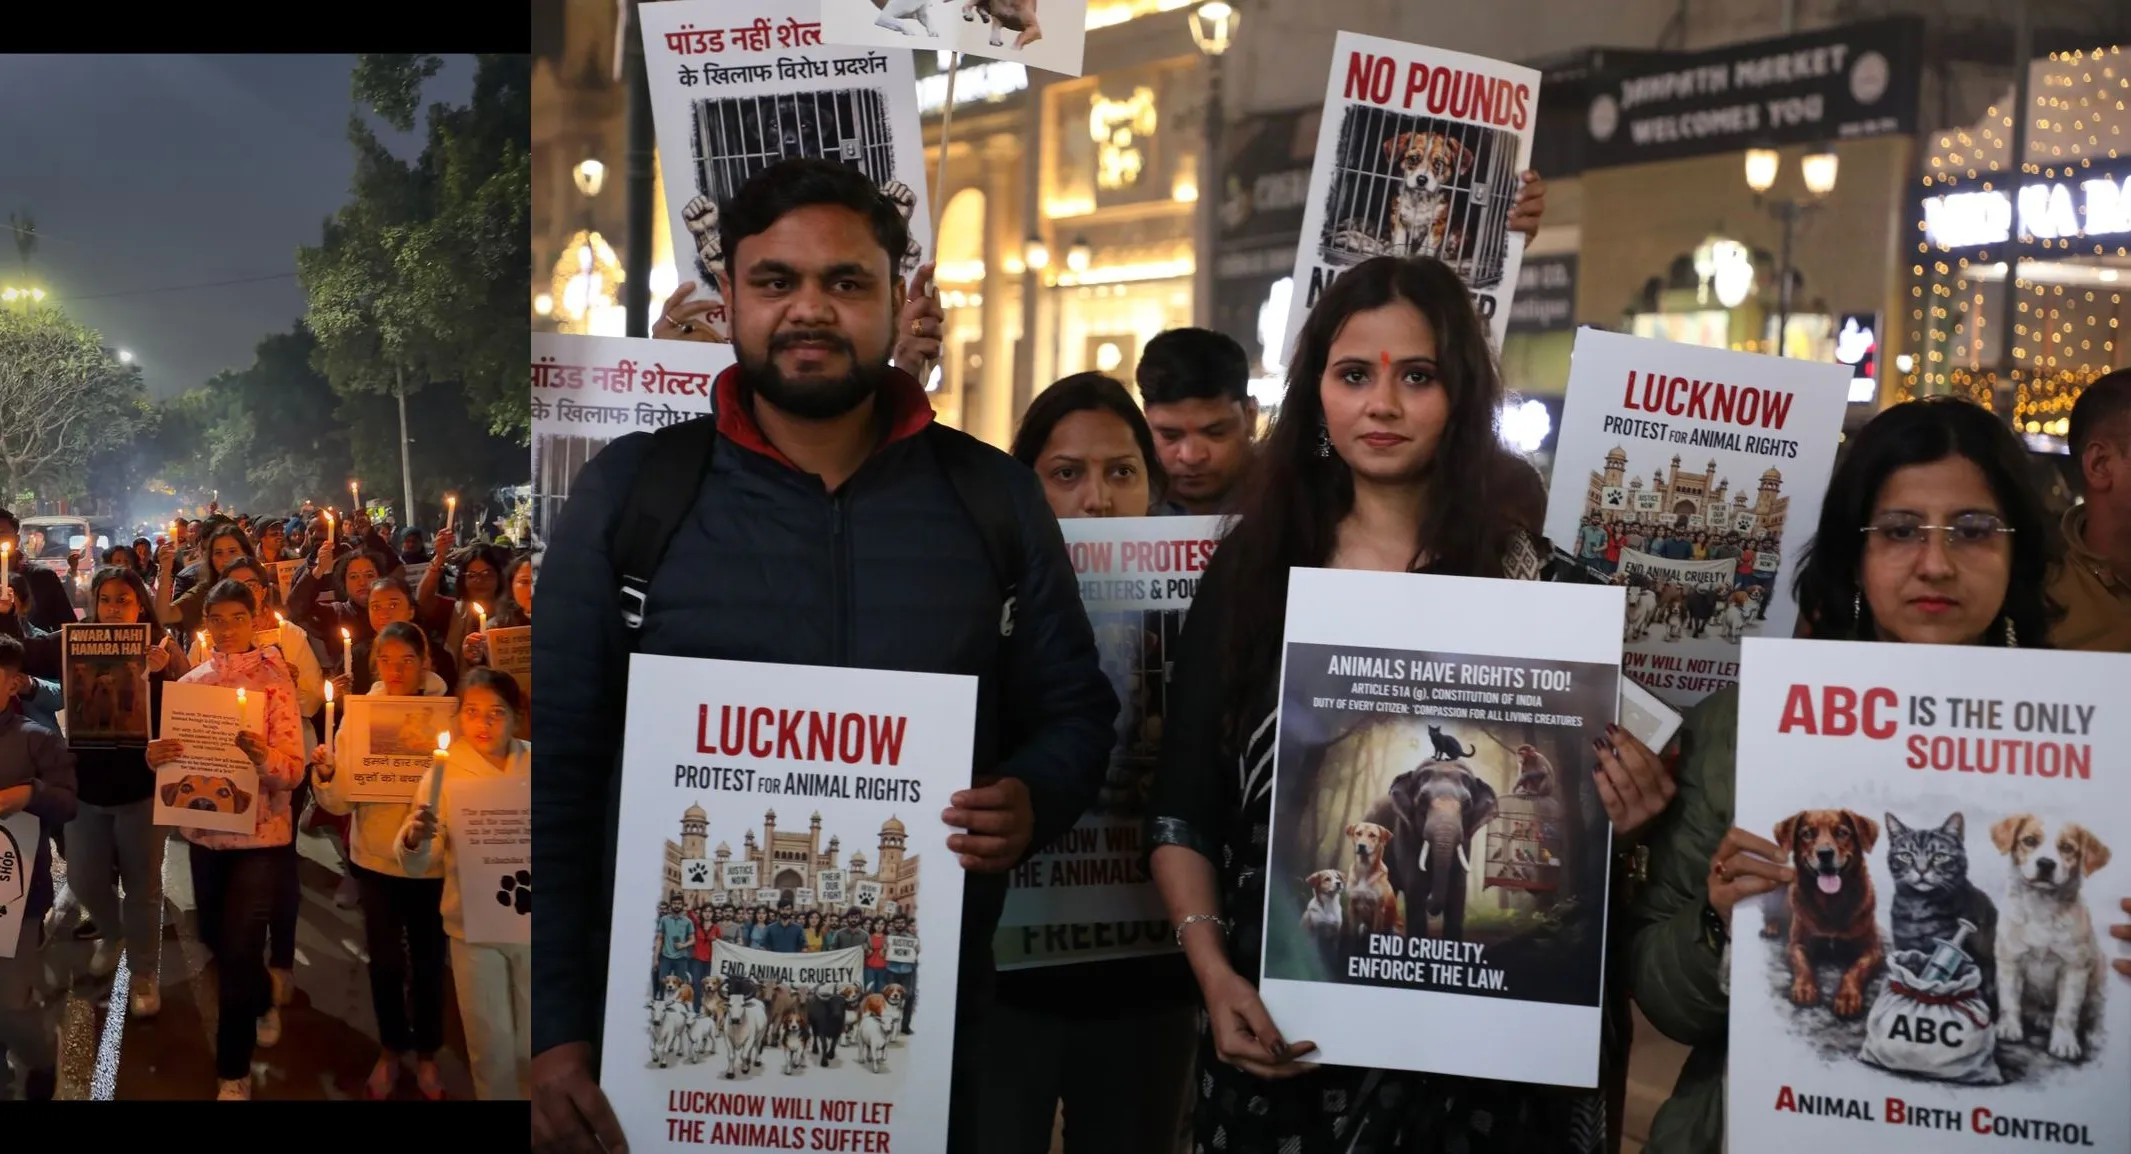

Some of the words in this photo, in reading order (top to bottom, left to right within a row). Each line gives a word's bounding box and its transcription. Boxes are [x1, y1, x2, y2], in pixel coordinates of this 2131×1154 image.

[730, 17, 772, 52] नहीं
[678, 64, 698, 87] के
[703, 62, 772, 86] खिलाफ
[776, 56, 828, 81] विरोध
[1733, 43, 1849, 87] MARKET
[1343, 51, 1396, 105] NO
[1403, 61, 1530, 131] POUNDS
[1630, 103, 1761, 145] WELCOMES
[1766, 93, 1824, 128] YOU
[592, 359, 638, 393] नहीं
[641, 362, 711, 397] शेल्टर
[556, 398, 630, 425] खिलाफ
[1623, 370, 1794, 430] LUCKNOW
[1603, 415, 1669, 441] PROTEST
[1669, 429, 1688, 445] FOR
[1689, 428, 1743, 452] ANIMAL
[1745, 435, 1798, 459] RIGHTS
[1079, 579, 1145, 600] HELTERS
[1150, 579, 1163, 600] &
[1647, 566, 1682, 582] ANIMAL
[1685, 570, 1727, 584] CRUELTY
[69, 628, 112, 642] AWARA
[114, 629, 143, 642] NAHI
[71, 643, 120, 656] HAMARA
[121, 643, 141, 656] HAI
[1327, 654, 1405, 681] ANIMALS
[1410, 659, 1455, 684] HAVE
[1460, 664, 1525, 689] RIGHTS
[1530, 669, 1572, 692] TOO!
[1651, 654, 1682, 672] WILL
[1686, 658, 1717, 674] NOT
[1717, 661, 1740, 677] LET
[1313, 697, 1334, 709] DUTY
[1336, 699, 1347, 709] OF
[1348, 700, 1374, 711] EVERY
[1469, 708, 1485, 720] FOR
[1486, 709, 1503, 721] ALL
[1505, 711, 1533, 723] LIVING
[1534, 713, 1583, 727] CREATURES
[1351, 683, 1390, 697] ARTICLE
[1392, 685, 1410, 698] 51A
[1432, 688, 1500, 705] CONSTITUTION
[1501, 692, 1514, 705] OF
[1516, 694, 1543, 708] INDIA
[1778, 683, 1898, 741] ABC
[1908, 695, 1936, 728] IS
[1946, 697, 2003, 731] THE
[2014, 700, 2096, 736] ONLY
[696, 703, 907, 766] LUCKNOW
[1906, 734, 2092, 780] SOLUTION
[675, 764, 756, 793] PROTEST
[758, 777, 781, 794] FOR
[784, 772, 850, 799] ANIMAL
[855, 776, 921, 804] RIGHTS
[727, 864, 754, 876] JUSTICE
[822, 871, 841, 881] THEIR
[825, 881, 839, 891] OUR
[822, 891, 842, 901] FIGHT
[1369, 933, 1401, 956] END
[1408, 937, 1488, 965] CRUELTY.
[720, 959, 745, 976] END
[750, 963, 795, 983] ANIMAL
[800, 967, 854, 984] CRUELTY
[1348, 956, 1425, 983] ENFORCE
[1430, 963, 1462, 987] THE
[1467, 967, 1509, 991] LAW.
[1887, 1014, 1964, 1048] ABC
[668, 1090, 765, 1118] LUCKNOW
[772, 1097, 815, 1121] WILL
[820, 1100, 857, 1124] NOT
[862, 1103, 894, 1125] LET
[666, 1118, 704, 1144] THE
[710, 1122, 805, 1150] ANIMALS
[811, 1127, 890, 1154] SUFFER
